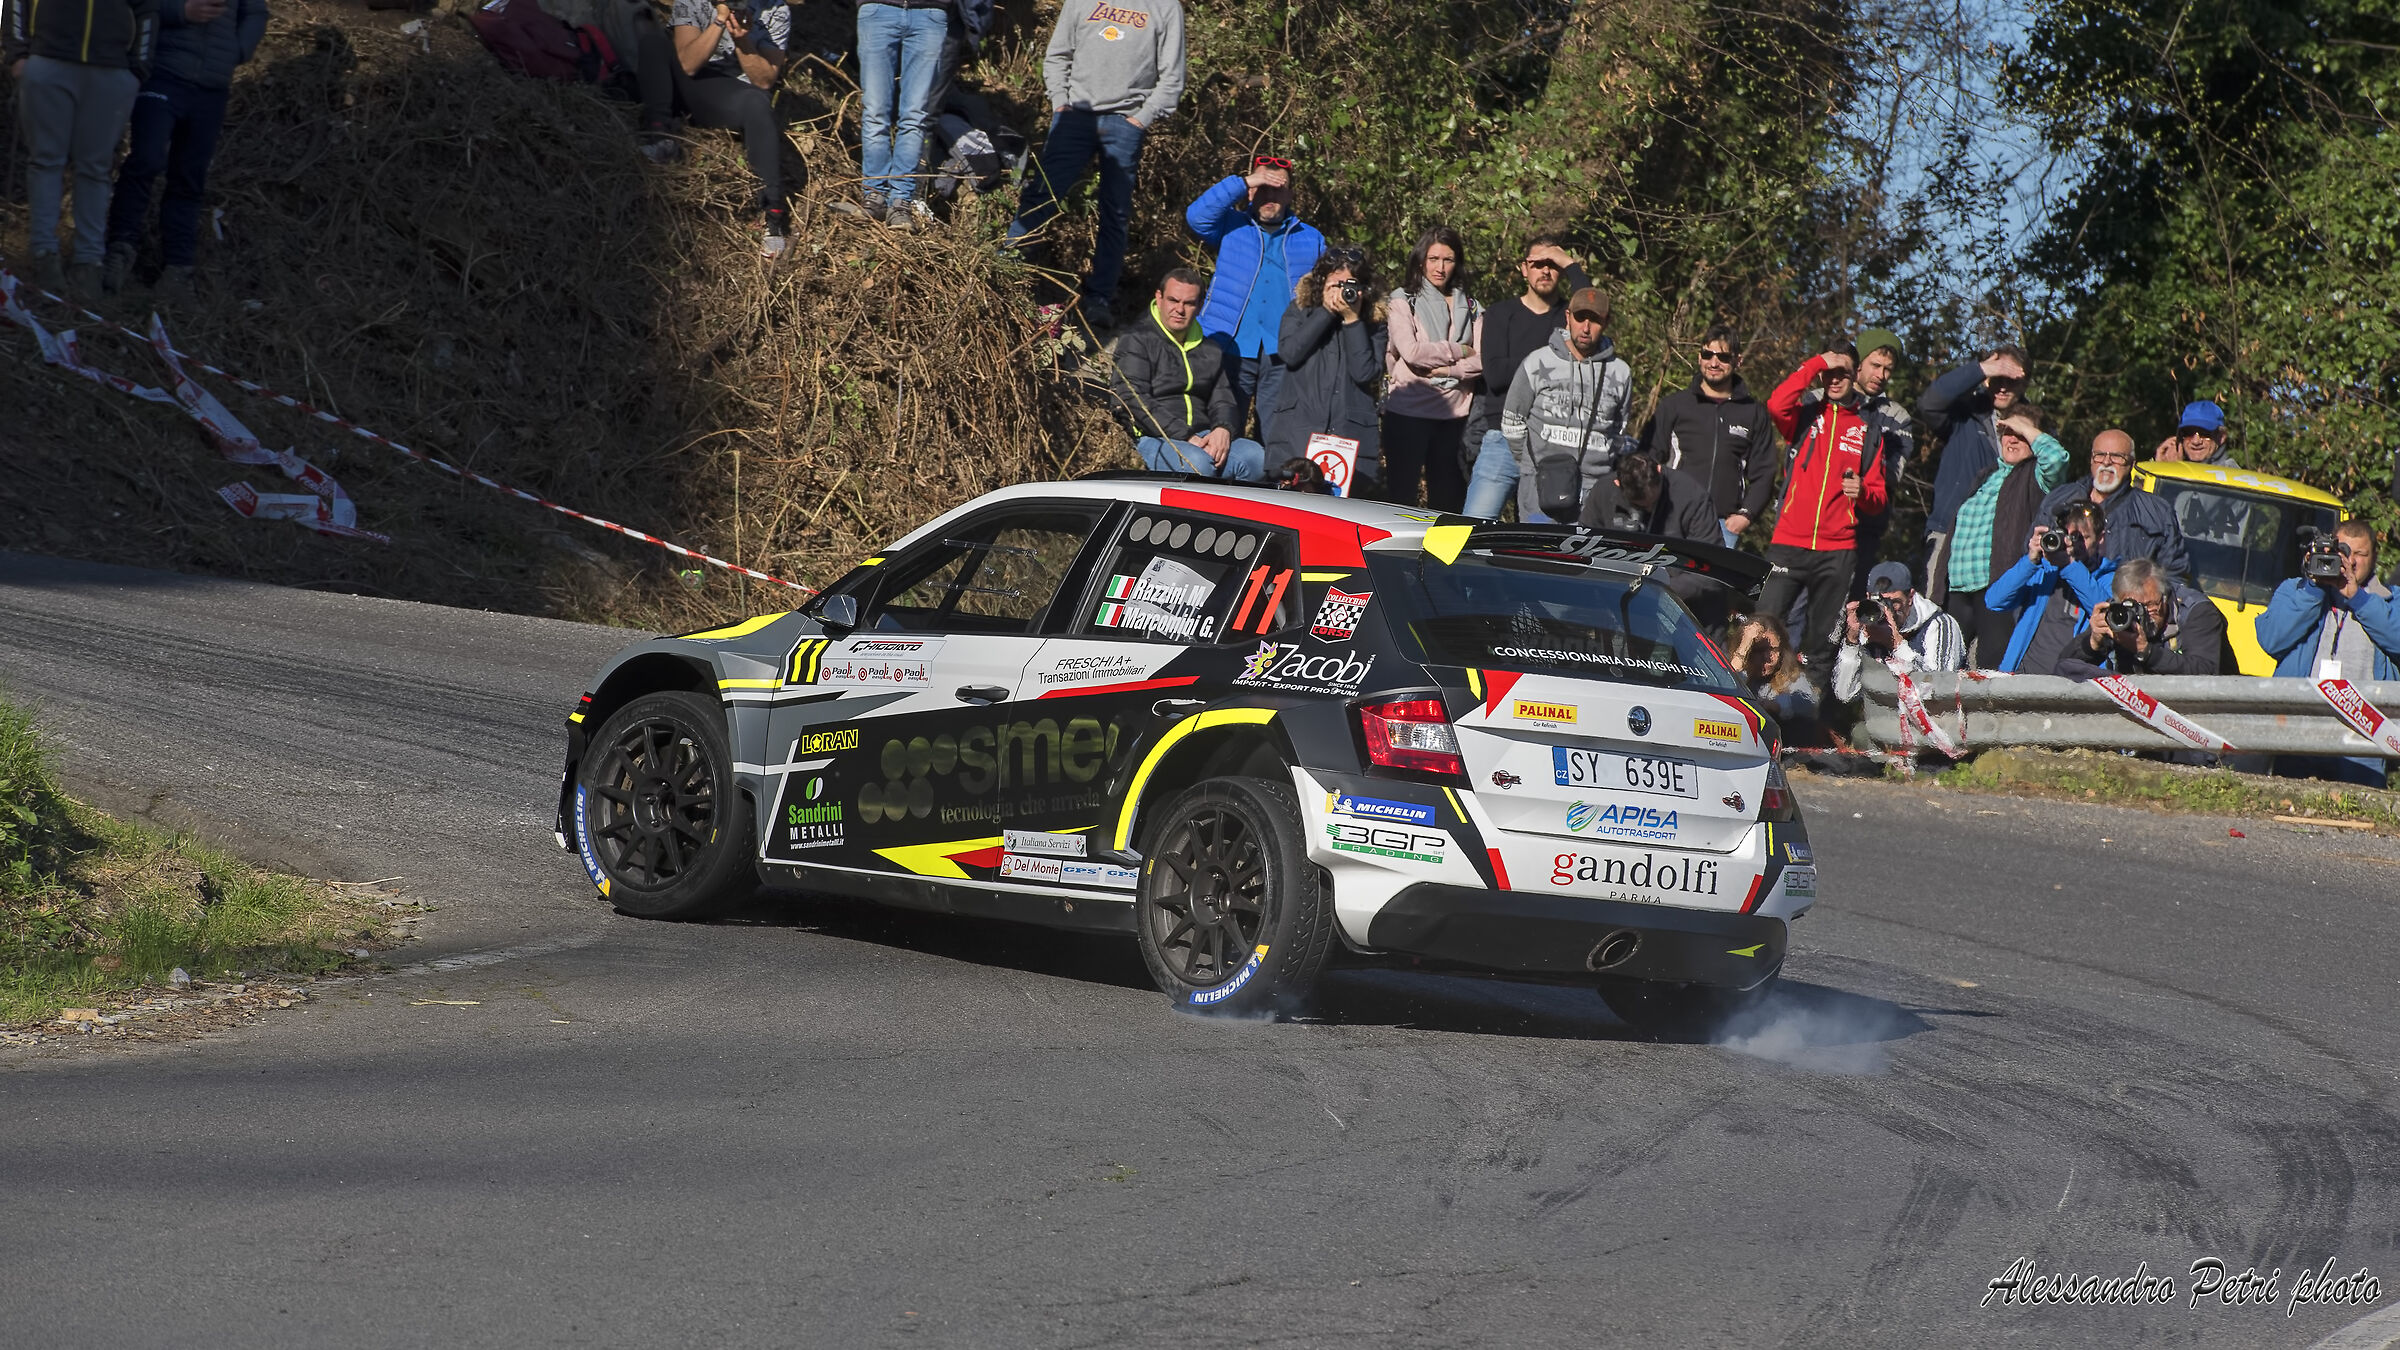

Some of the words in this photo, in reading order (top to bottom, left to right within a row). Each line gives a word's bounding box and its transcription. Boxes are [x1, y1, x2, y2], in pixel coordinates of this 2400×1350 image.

[1086, 1, 1149, 29] LAKERS
[2205, 469, 2292, 493] 144
[1132, 578, 1189, 605] Razzini
[1232, 565, 1294, 635] 11
[1199, 615, 1215, 639] G.
[1312, 625, 1352, 638] CORSE
[791, 639, 829, 683] 11
[1055, 656, 1113, 670] FRESCHI
[1494, 647, 1624, 667] CONCESSIONARIA
[1626, 657, 1680, 674] DAVIGHI
[1038, 669, 1091, 684] Transazioni
[1091, 665, 1146, 680] Immobiliari
[1231, 679, 1267, 688] IMPORT
[1272, 682, 1309, 692] EXPORT
[2321, 681, 2374, 732] PERICOLOSA
[2340, 684, 2364, 711] ZONA
[1519, 704, 1573, 720] PALINAL
[802, 729, 859, 754] LORAN
[1698, 723, 1738, 738] PALINAL
[1556, 769, 1568, 780] CZ
[1571, 751, 1600, 783] SY
[1625, 757, 1686, 793] 639E
[788, 801, 842, 825] Sandrini
[940, 800, 1014, 824] tecnologia
[1356, 803, 1426, 819] MICHELIN
[1599, 804, 1678, 829] APISA
[576, 792, 597, 872] MICHELIN
[790, 823, 843, 840] METALLI
[1021, 836, 1047, 848] Italiana
[1047, 838, 1071, 849] Servizi
[1596, 825, 1677, 840] AUTOTRASPORTI
[1336, 843, 1441, 862] TRADING
[1014, 858, 1030, 871] Del
[1030, 860, 1060, 874] Monte
[1063, 866, 1097, 875] GPS
[1107, 870, 1137, 878] GPS
[1550, 853, 1718, 895] gandolfi
[1609, 890, 1663, 905] PARMA
[1194, 966, 1251, 1003] MICHELIN
